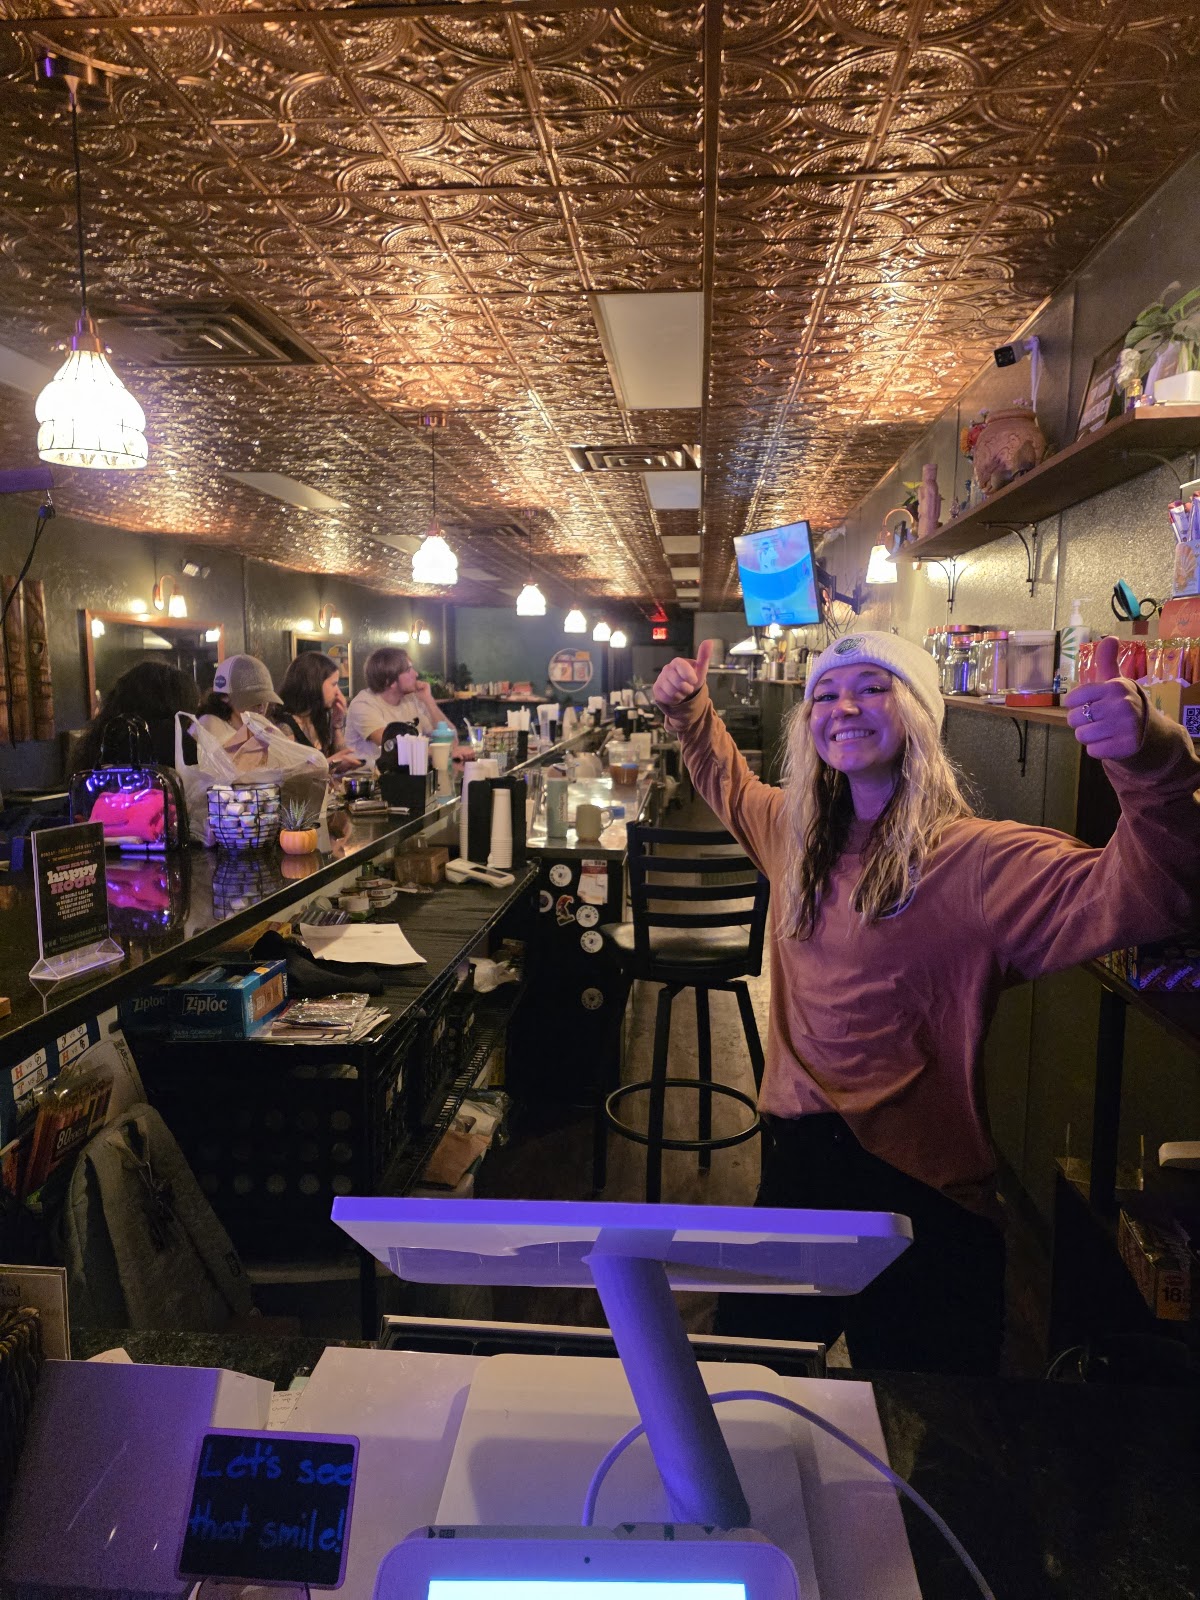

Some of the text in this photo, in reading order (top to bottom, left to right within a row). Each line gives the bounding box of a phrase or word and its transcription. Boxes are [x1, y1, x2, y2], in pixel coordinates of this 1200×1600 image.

[46, 863, 98, 885] happy
[51, 876, 97, 895] HOUR
[1139, 963, 1167, 989] Skittles
[1164, 964, 1194, 989] Skittles
[186, 996, 228, 1015] Ziploc
[56, 1127, 71, 1150] 80
[201, 1441, 353, 1486] Let's see
[189, 1500, 345, 1553] that smile!
